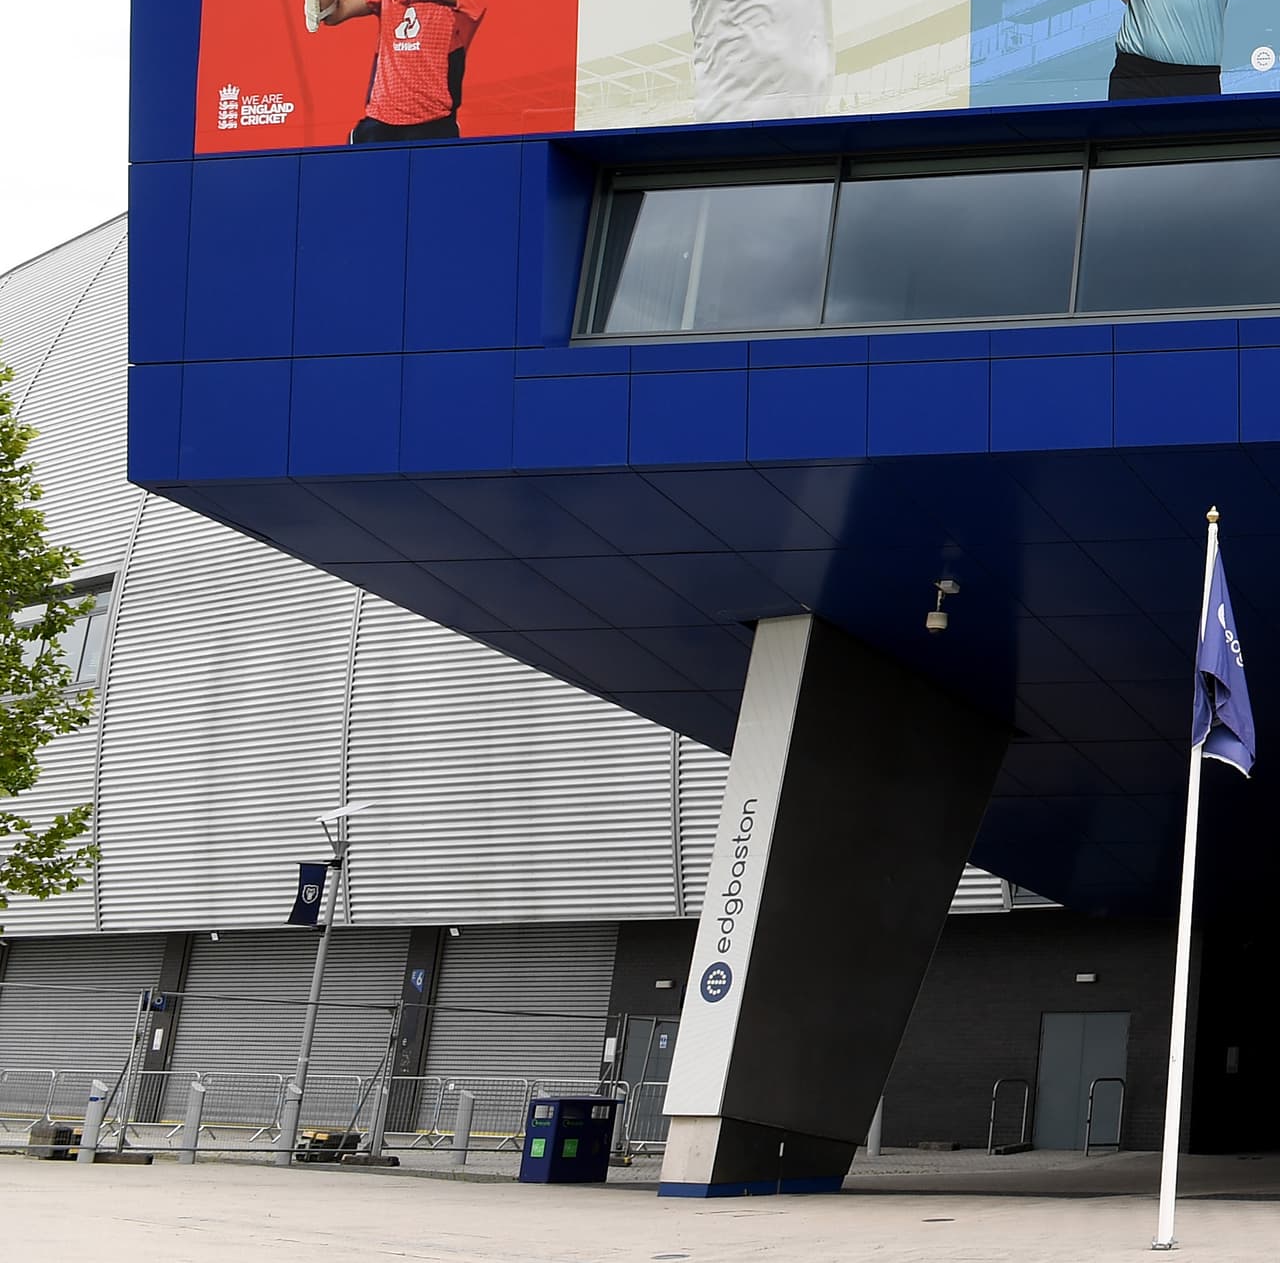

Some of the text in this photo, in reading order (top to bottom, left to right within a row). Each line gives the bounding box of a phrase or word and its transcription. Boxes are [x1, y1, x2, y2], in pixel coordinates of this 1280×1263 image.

[241, 93, 284, 105] WE ARE
[241, 102, 294, 116] ENGLAND
[240, 113, 288, 126] CRICKET
[717, 799, 758, 953] edgbaston
